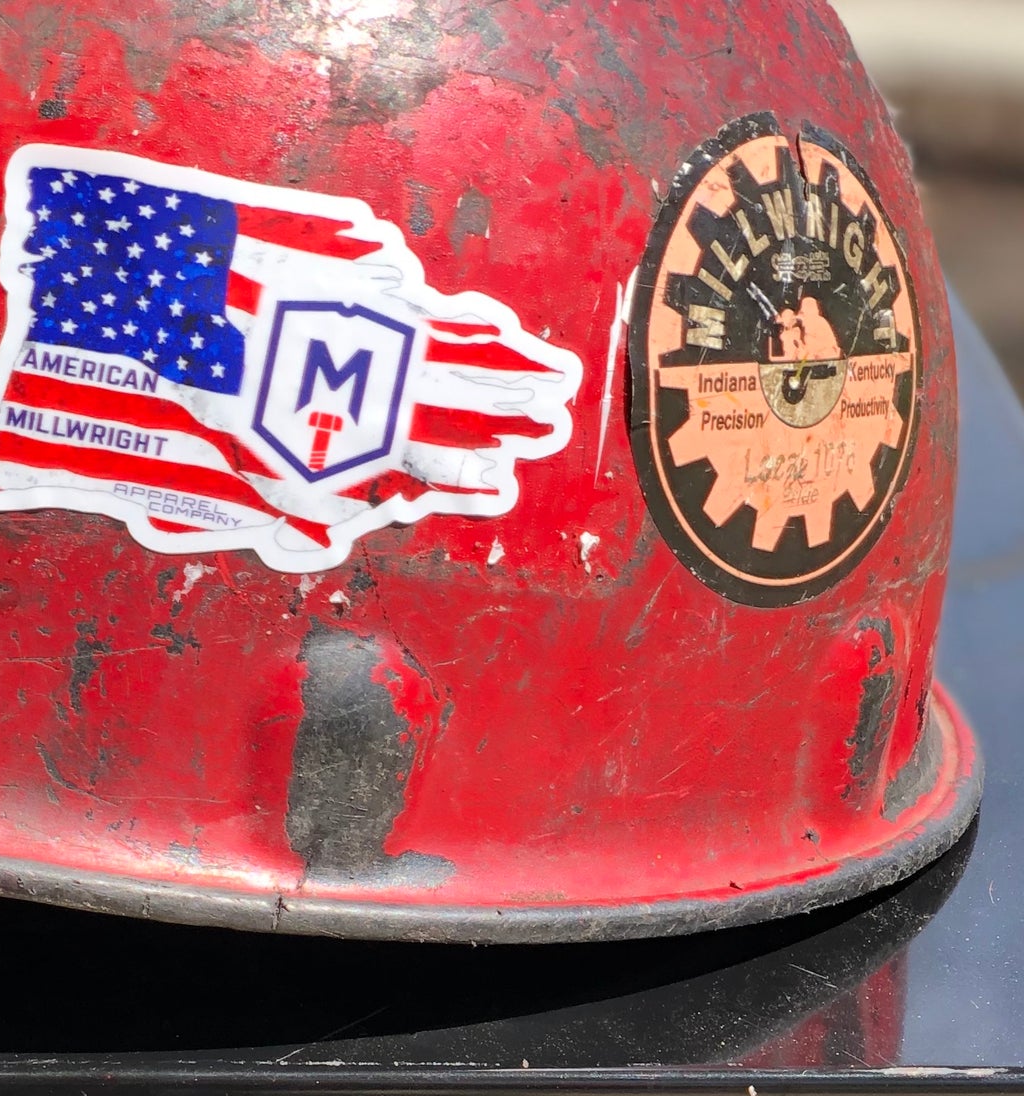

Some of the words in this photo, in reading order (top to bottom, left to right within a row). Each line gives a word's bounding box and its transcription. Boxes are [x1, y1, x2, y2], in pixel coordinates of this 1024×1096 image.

[686, 188, 897, 351] MILLWRIGHT
[21, 348, 159, 394] AMERICAN
[698, 371, 757, 394] Indiana
[849, 359, 896, 384] Kentucky
[840, 395, 890, 420] Productivity
[5, 406, 168, 457] MILLWRIGHT
[701, 411, 764, 432] Precision
[114, 483, 227, 516] APPAREL
[148, 502, 242, 527] COMPANY
